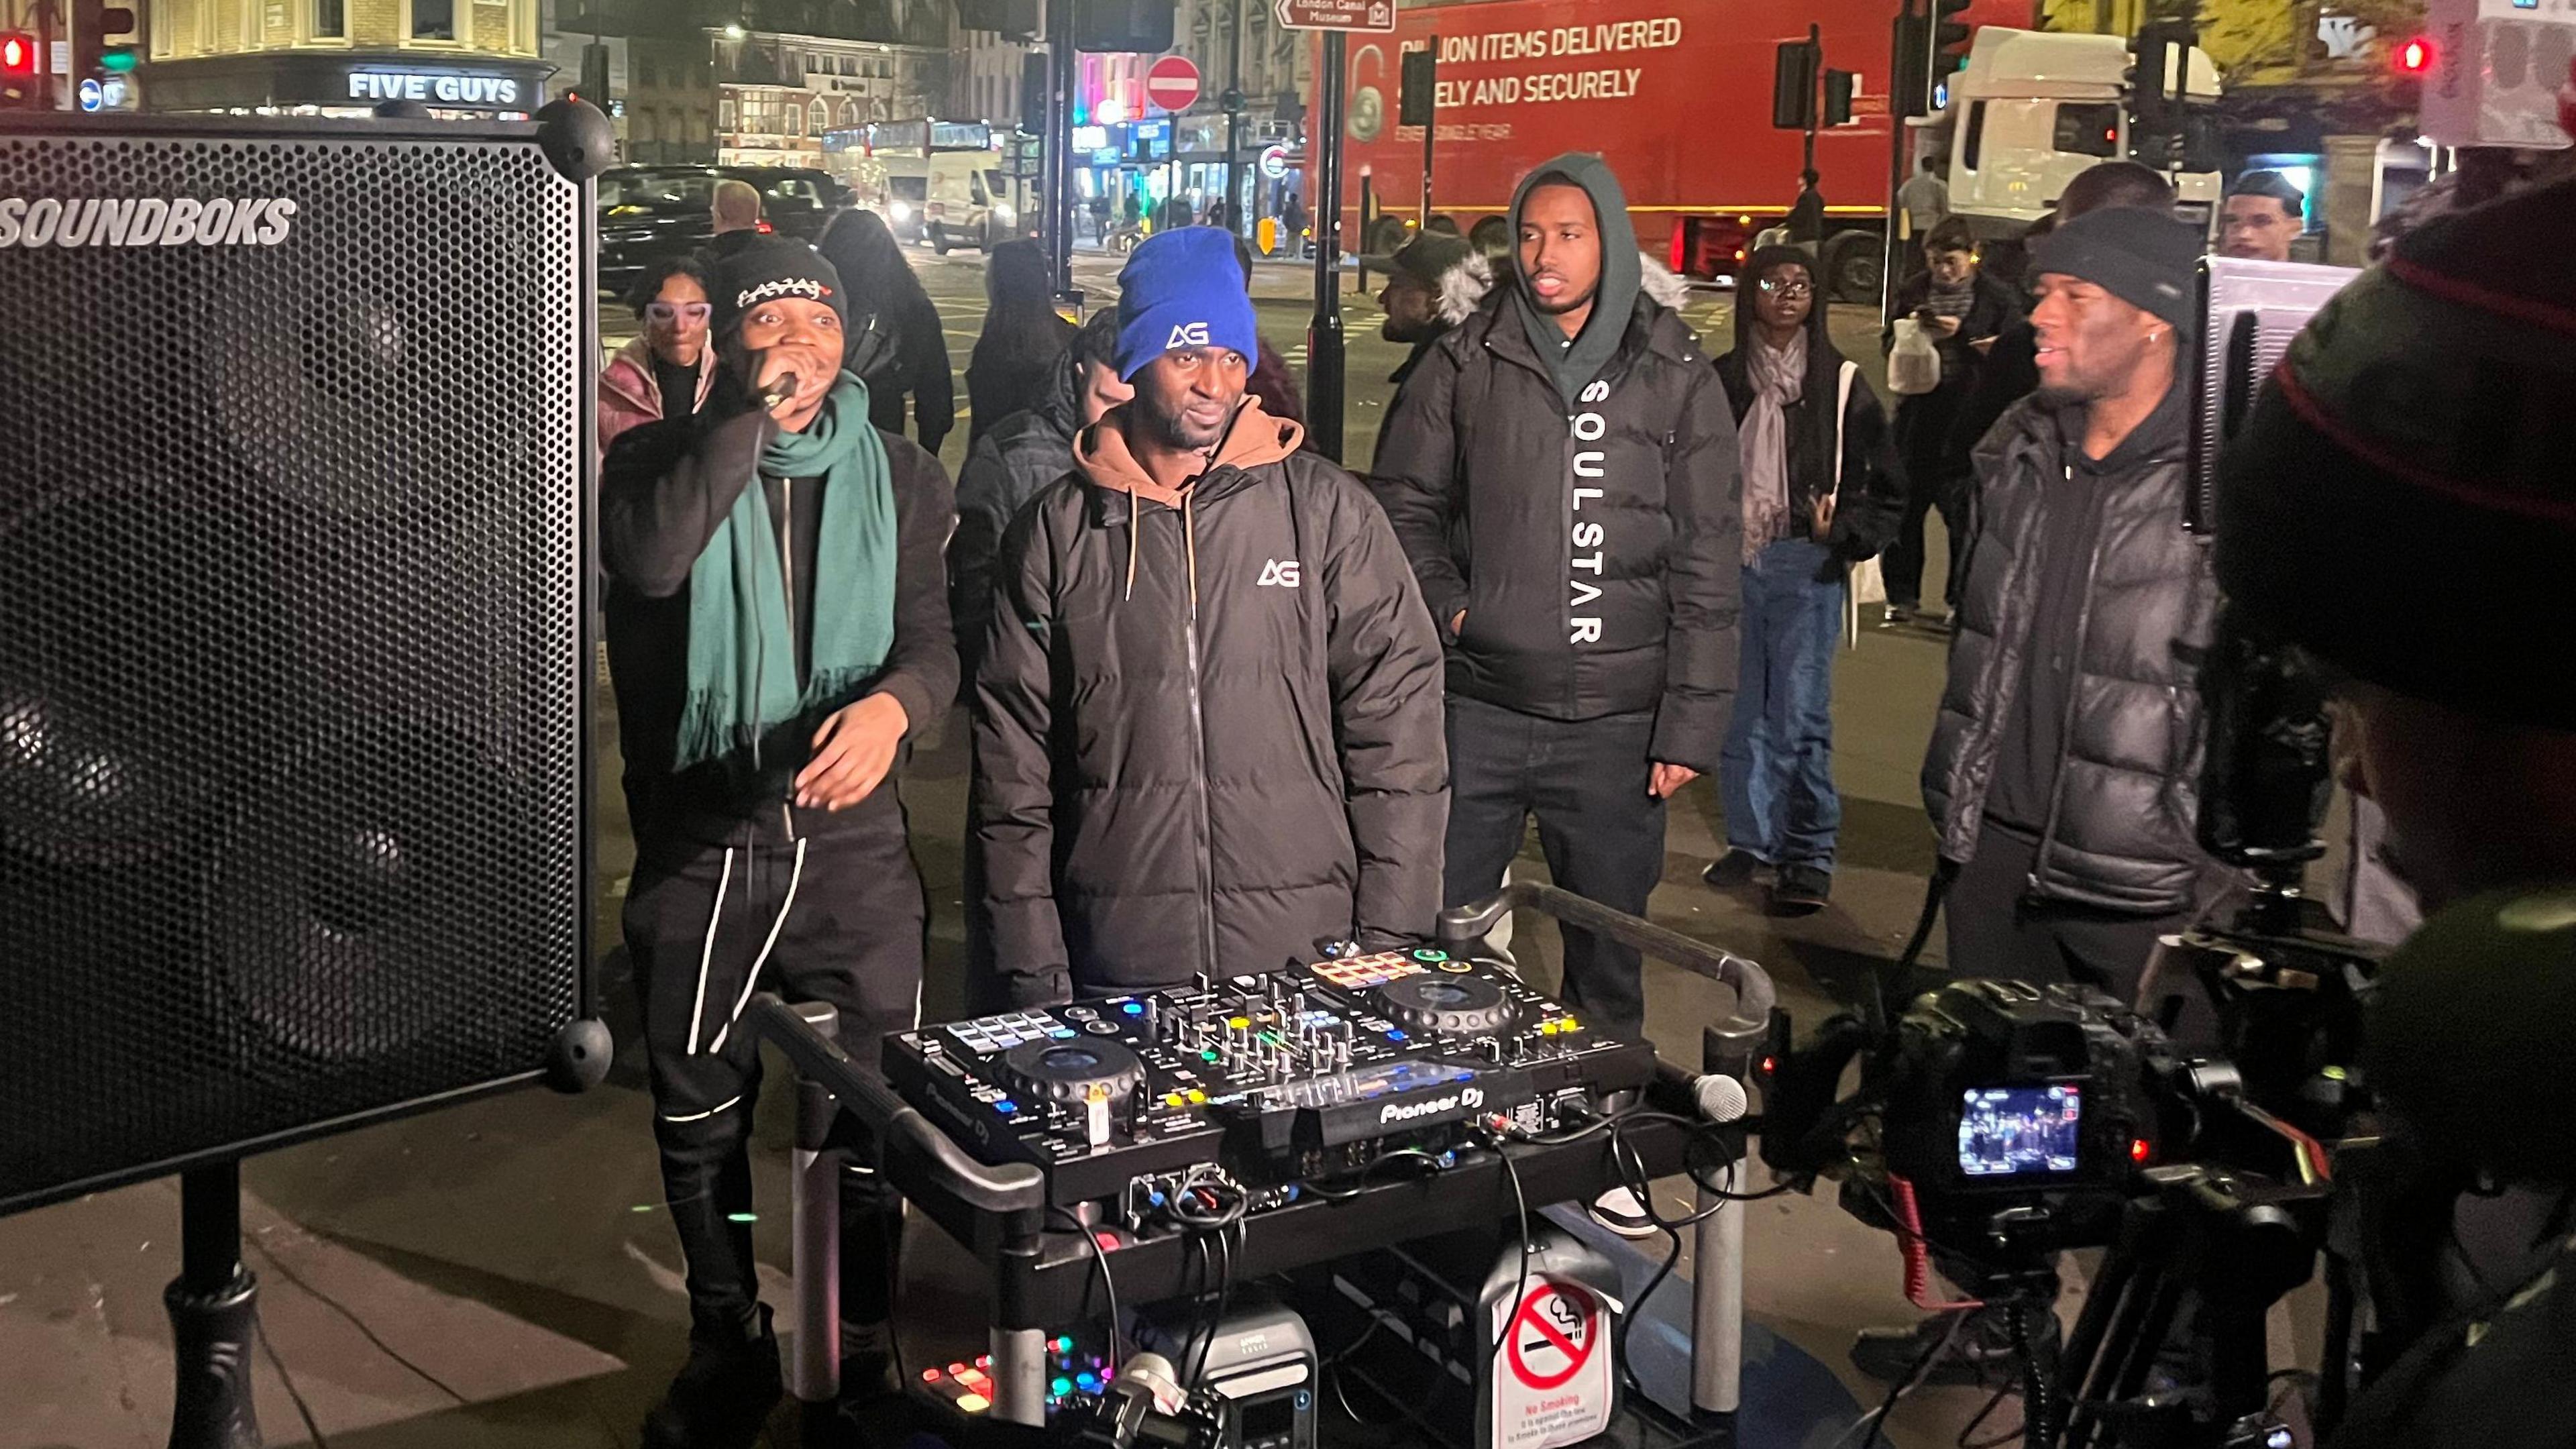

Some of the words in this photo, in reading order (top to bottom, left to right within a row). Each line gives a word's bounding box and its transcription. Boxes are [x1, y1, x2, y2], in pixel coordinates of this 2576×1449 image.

[1297, 0, 1334, 9] London
[1337, 0, 1366, 10] Canal
[1309, 11, 1352, 23] Museum
[1481, 30, 1548, 60] ITEMS
[1551, 17, 1682, 56] DELIVERED
[349, 72, 426, 100] FIVE
[435, 75, 517, 103] GUYS
[1472, 77, 1520, 105] AND
[1523, 68, 1642, 102] SECURELY
[0, 198, 297, 248] SOUNDBOKS
[1570, 380, 1610, 645] SOULSTAR
[1380, 1095, 1459, 1124] Pioneer
[1525, 1405, 1538, 1416] No
[1541, 1395, 1580, 1412] Smoking
